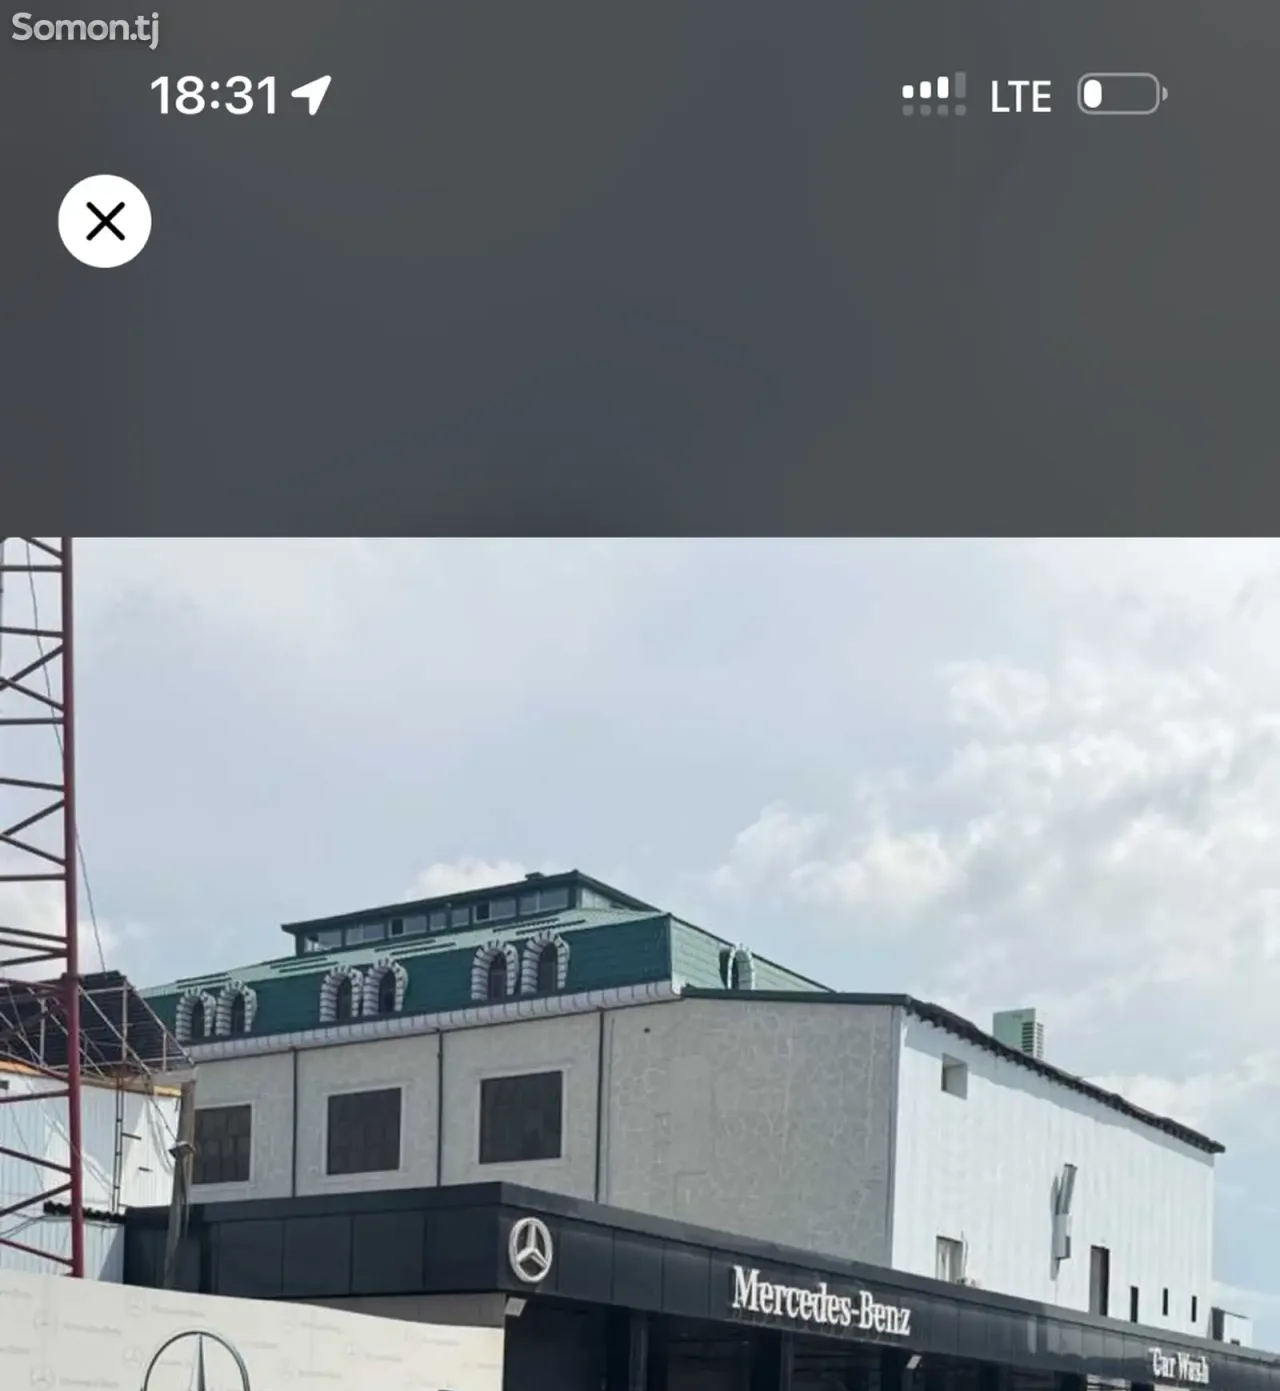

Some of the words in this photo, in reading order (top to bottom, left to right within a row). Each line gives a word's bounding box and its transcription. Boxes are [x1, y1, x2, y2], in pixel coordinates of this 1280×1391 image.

[732, 1265, 911, 1336] Mercedes-Benz
[1150, 1347, 1176, 1377] Car
[1178, 1352, 1209, 1384] Wash
